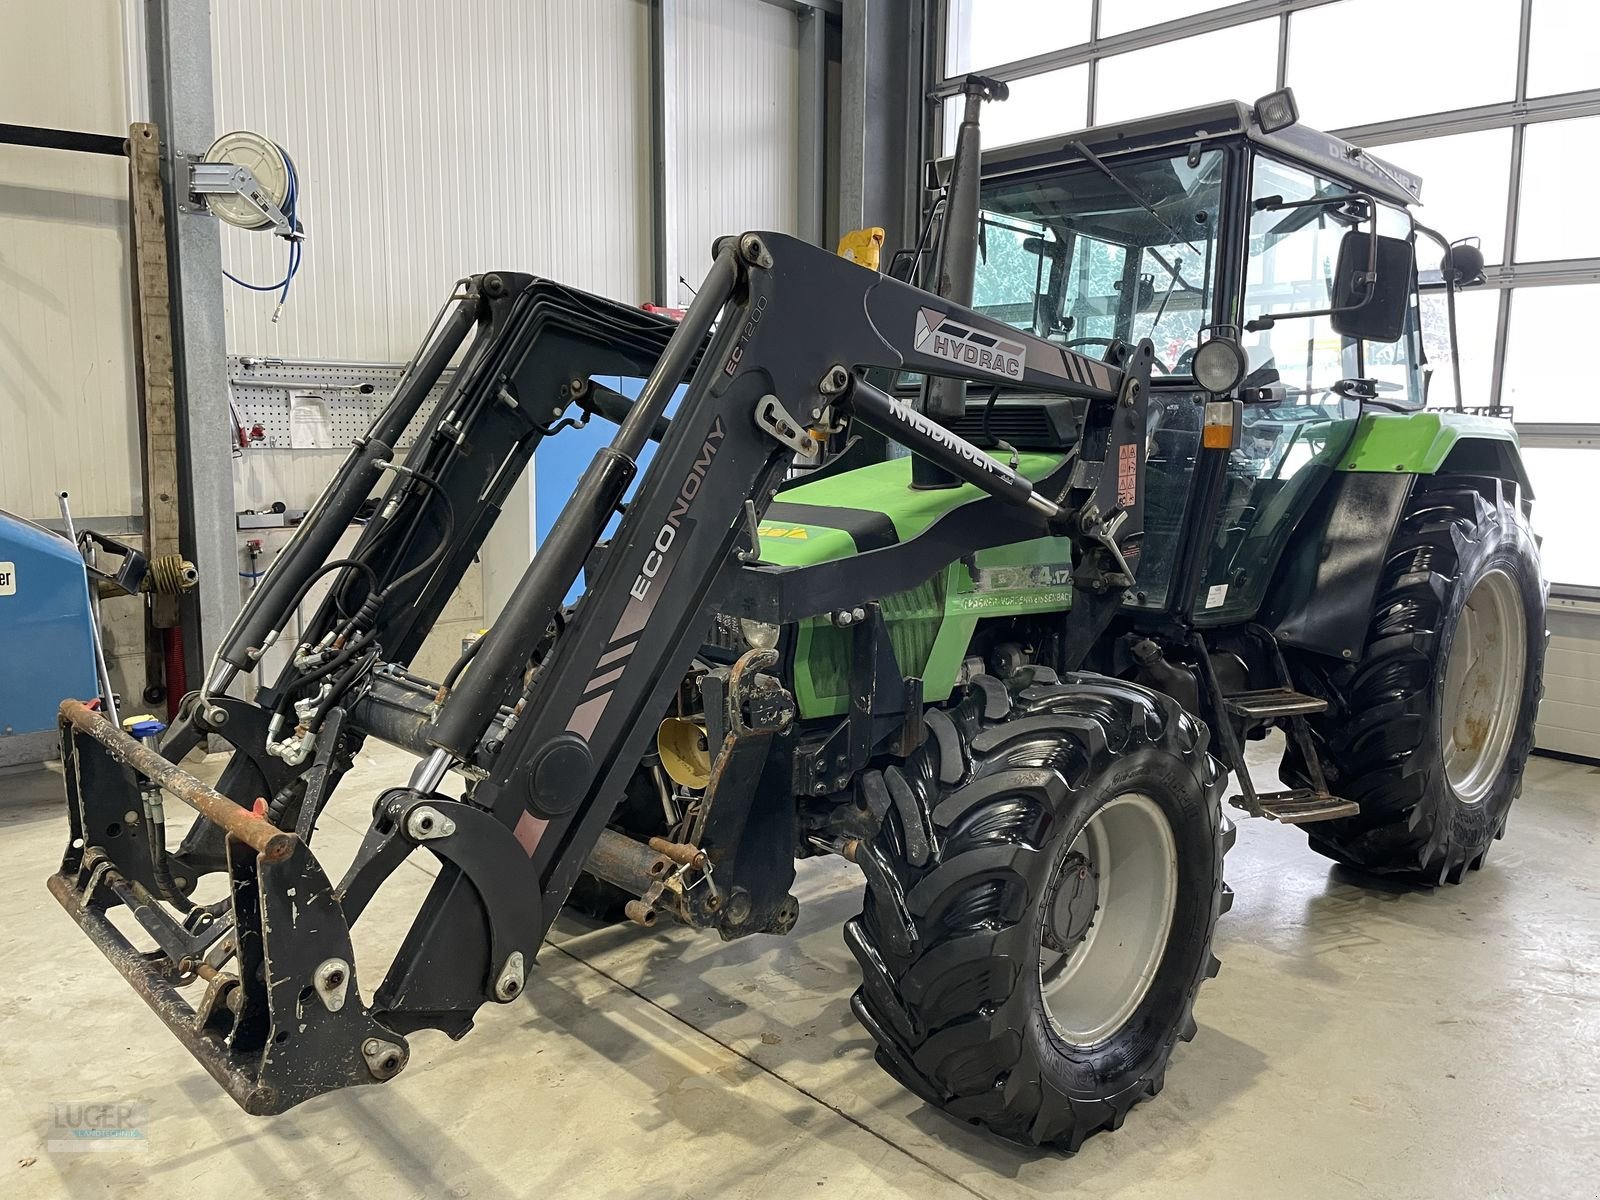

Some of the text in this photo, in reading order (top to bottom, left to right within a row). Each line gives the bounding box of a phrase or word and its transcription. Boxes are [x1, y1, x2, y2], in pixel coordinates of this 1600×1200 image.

[725, 295, 768, 377] EC 1200
[933, 335, 1020, 377] HYDRAC
[629, 416, 726, 602] ECONOMY
